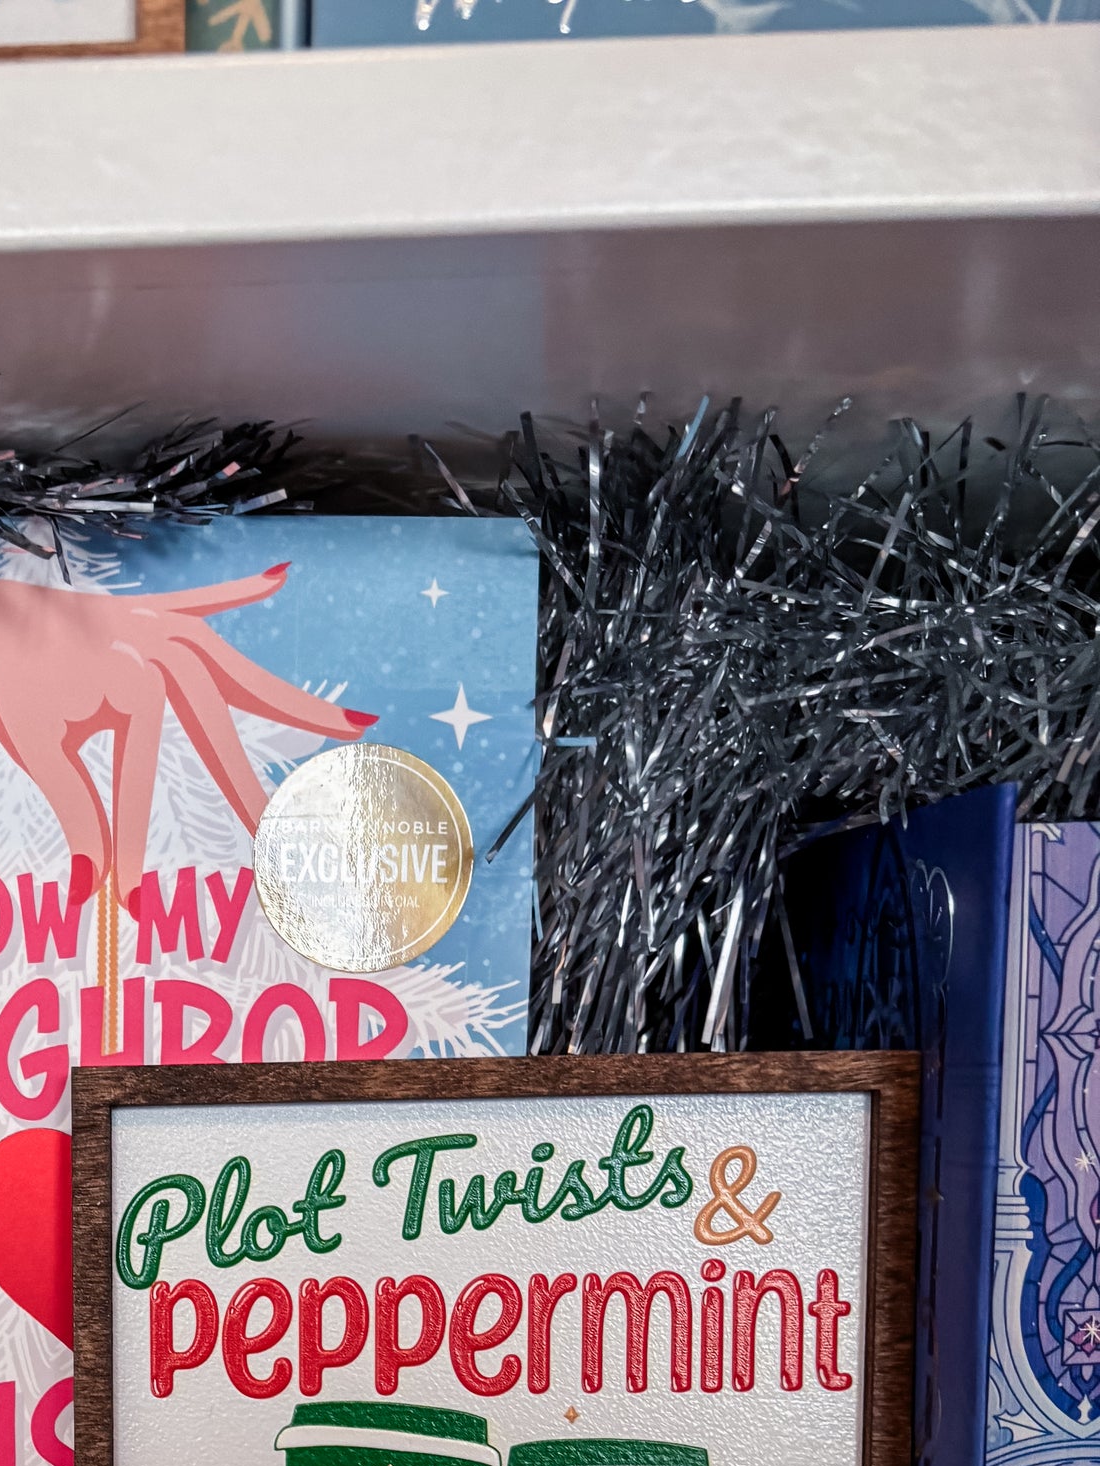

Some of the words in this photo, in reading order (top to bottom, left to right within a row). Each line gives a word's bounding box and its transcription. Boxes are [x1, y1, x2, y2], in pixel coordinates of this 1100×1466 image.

[384, 820, 448, 836] NOBLE
[136, 865, 255, 966] MY
[116, 1147, 347, 1291] Plot
[373, 1103, 695, 1242] Twists
[694, 1144, 782, 1246] &
[149, 1257, 853, 1400] peppermint
